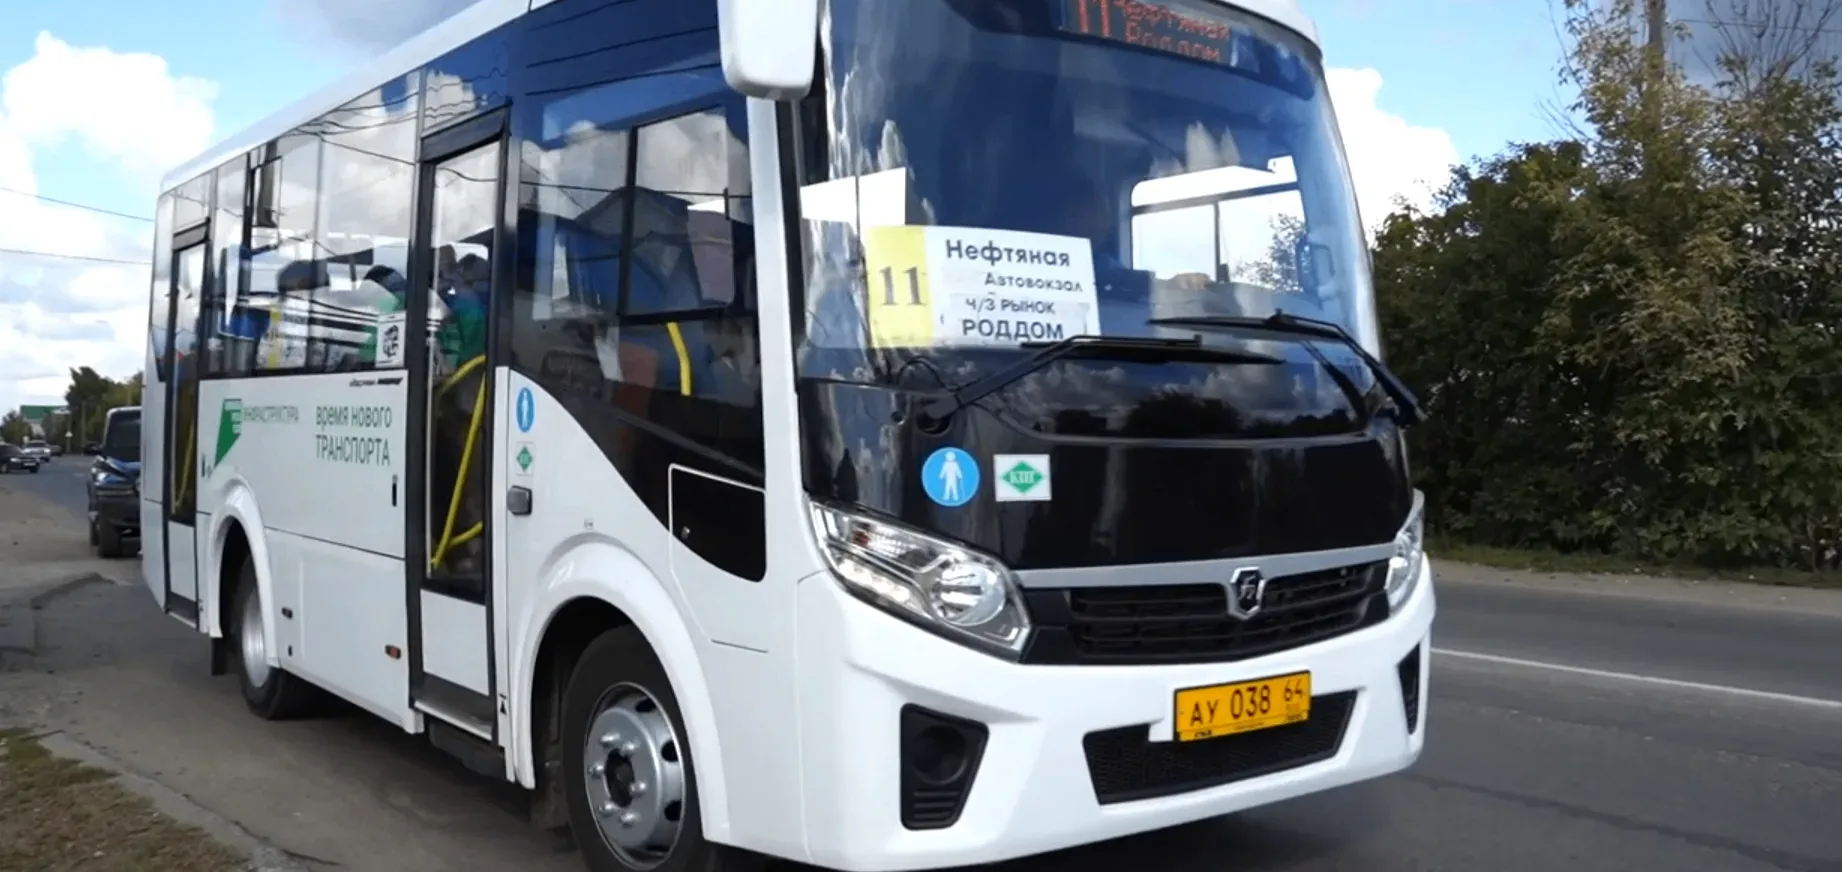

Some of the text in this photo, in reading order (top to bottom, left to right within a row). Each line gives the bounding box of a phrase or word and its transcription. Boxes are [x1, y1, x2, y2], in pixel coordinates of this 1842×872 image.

[945, 239, 1070, 267] Нефтяная
[878, 266, 927, 306] 11
[984, 272, 1083, 293] Автовокзал
[1000, 299, 1056, 315] РЫНОК
[962, 319, 1064, 341] РОДДОМ
[316, 435, 391, 466] ТРАНСПОРТА
[1230, 684, 1271, 719] 038
[1283, 679, 1303, 702] 64
